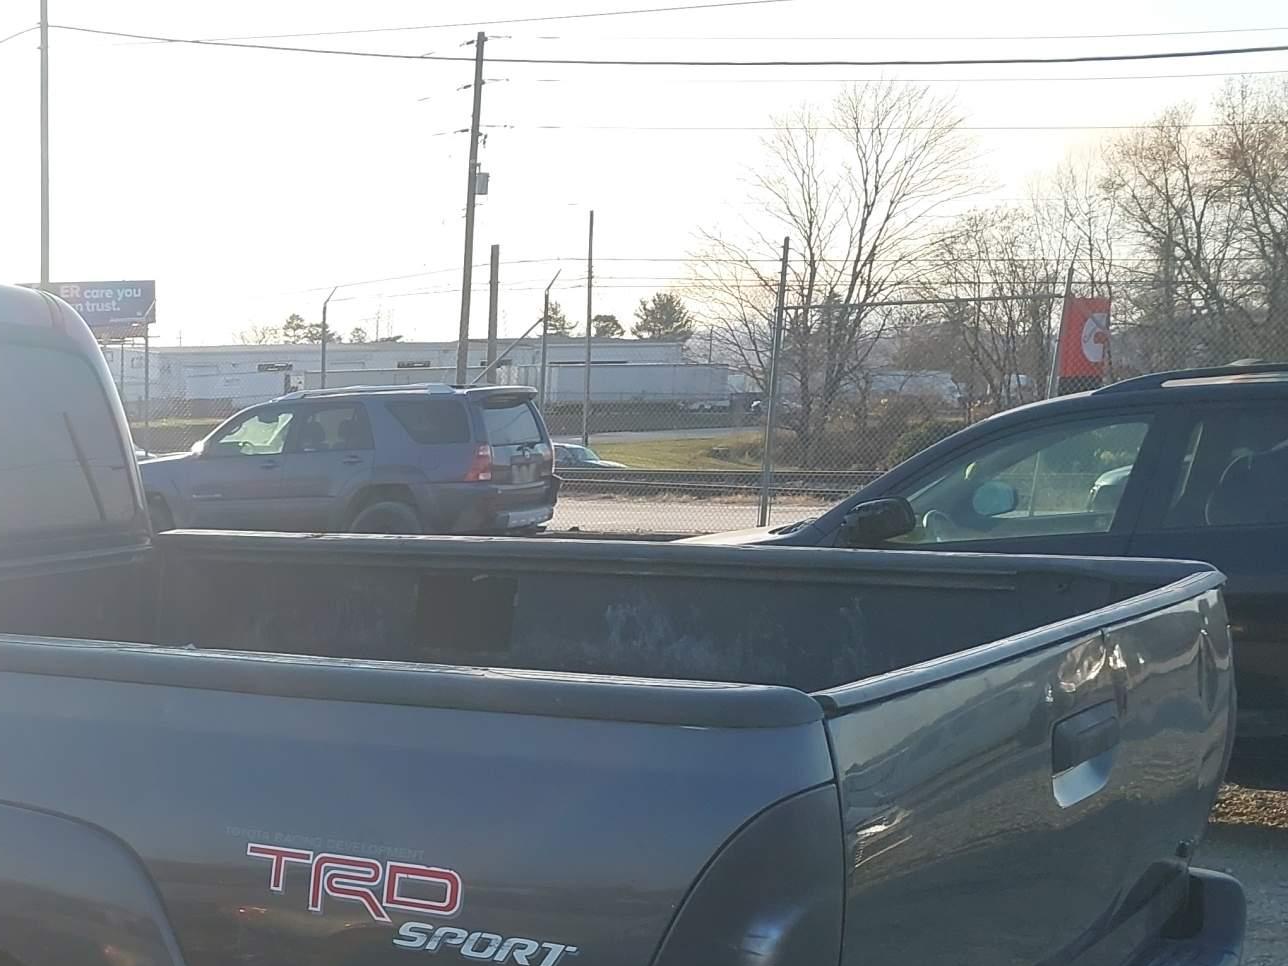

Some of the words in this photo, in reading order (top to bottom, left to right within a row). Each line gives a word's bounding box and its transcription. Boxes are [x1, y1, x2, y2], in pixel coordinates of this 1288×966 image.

[60, 285, 80, 298] ER
[83, 287, 113, 299] care
[117, 287, 142, 302] you
[85, 299, 121, 312] trust.
[246, 842, 464, 922] TRD
